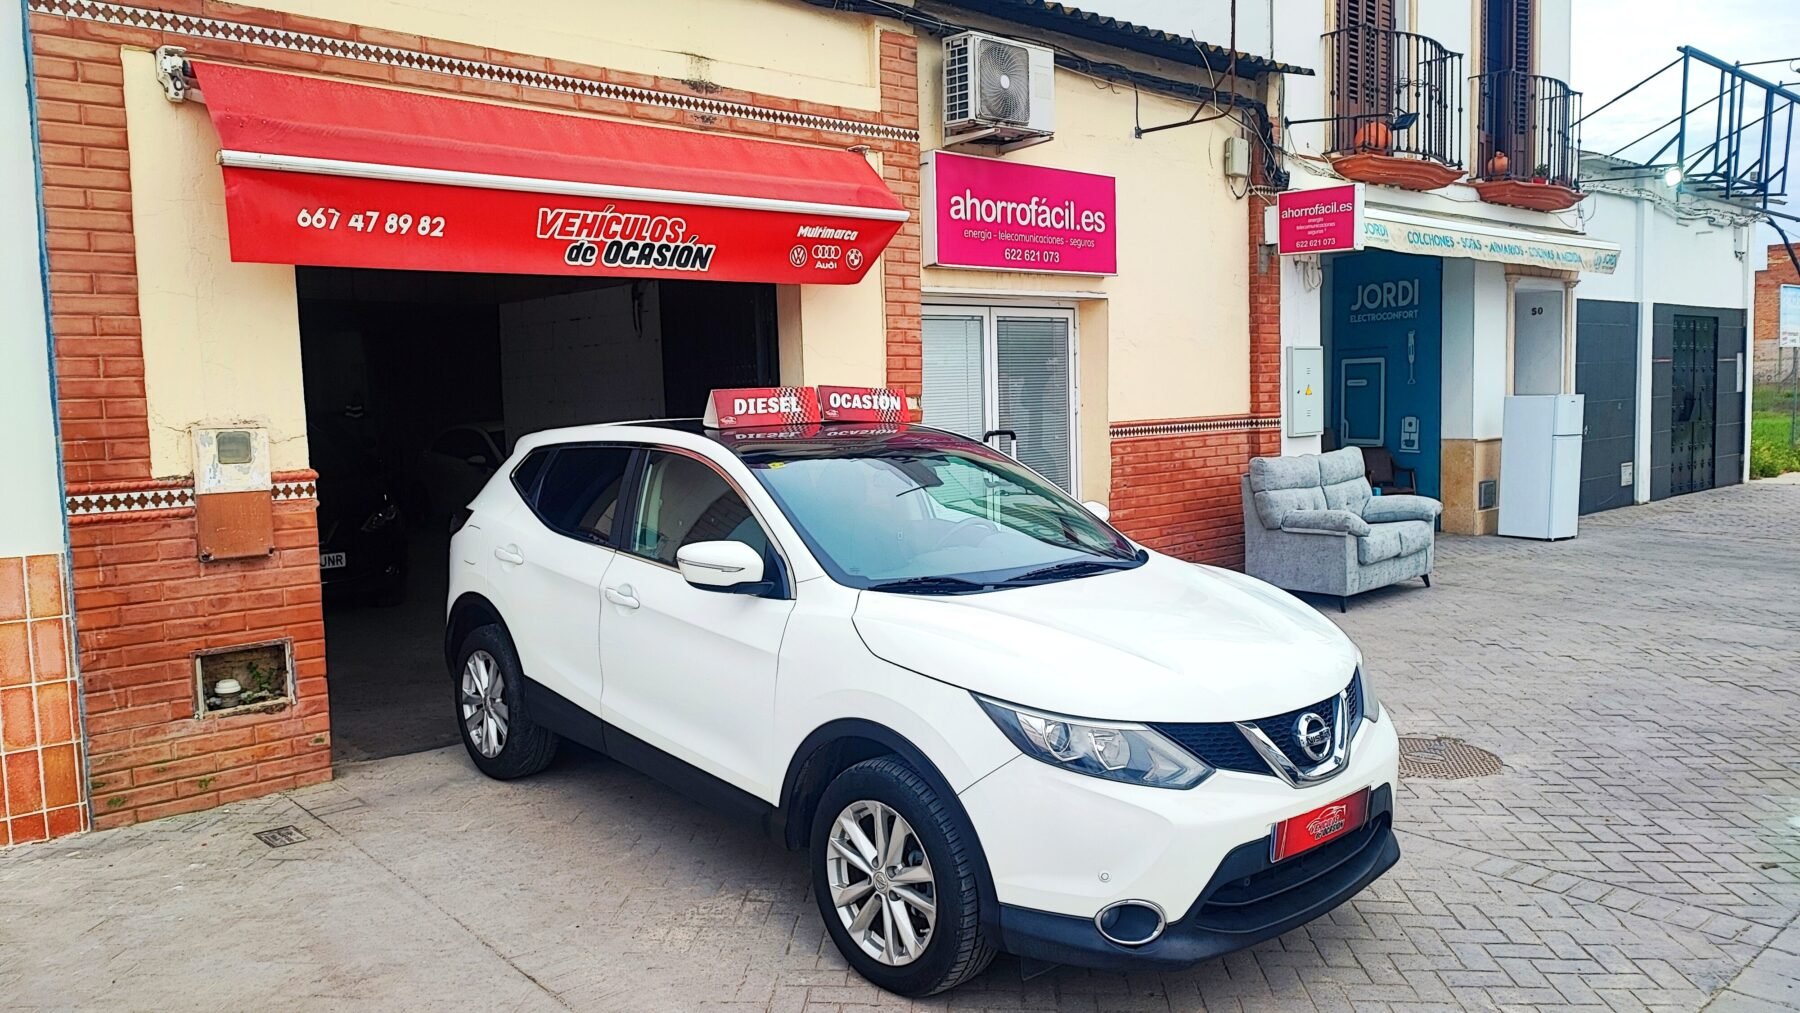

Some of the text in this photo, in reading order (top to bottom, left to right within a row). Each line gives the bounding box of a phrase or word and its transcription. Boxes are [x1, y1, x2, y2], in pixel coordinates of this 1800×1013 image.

[950, 188, 1106, 233] ahorrofácil.es
[1281, 201, 1353, 219] ahorrofácil.es
[297, 207, 446, 238] 667 47 89 82
[537, 205, 686, 243] VEHÍCULOS
[796, 225, 859, 241] Multimarca
[964, 229, 1095, 250] energía telecomunicaciones seguros
[1407, 231, 1454, 248] COLCHONES
[1295, 240, 1309, 248] 622
[1322, 237, 1336, 246] 073
[565, 235, 716, 271] de OCASIÓN
[1004, 248, 1060, 263] 622 621 073
[815, 260, 837, 270] Audi
[1351, 278, 1419, 311] JORDI
[1350, 309, 1419, 323] ELECTROCONFORT
[1531, 306, 1544, 316] 50
[734, 397, 802, 415] DIESEL
